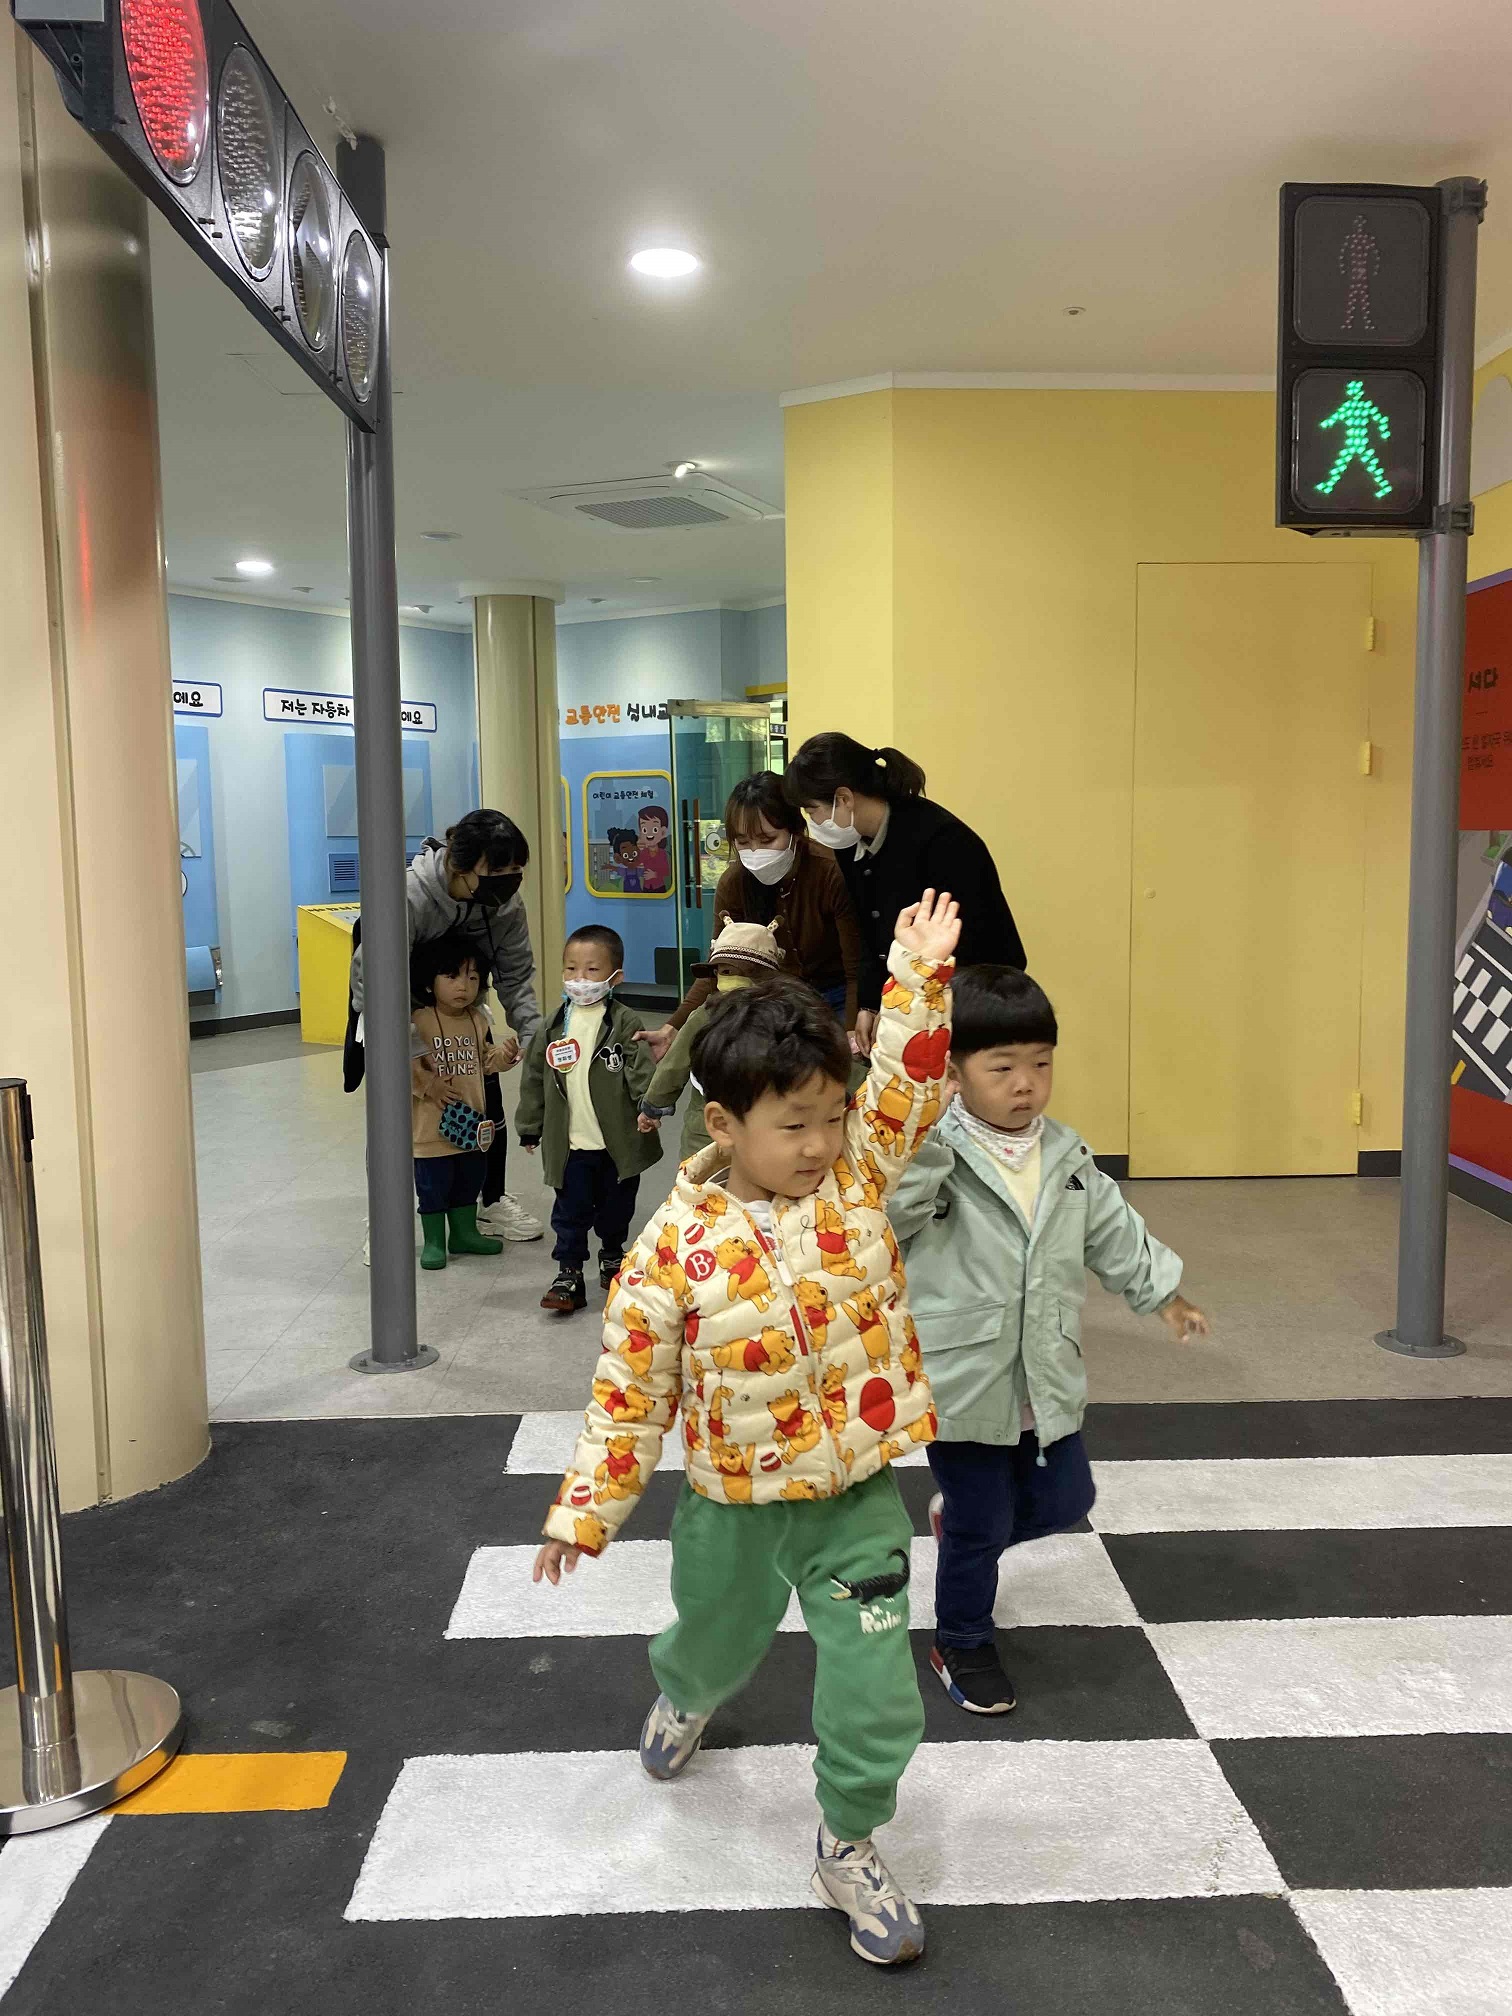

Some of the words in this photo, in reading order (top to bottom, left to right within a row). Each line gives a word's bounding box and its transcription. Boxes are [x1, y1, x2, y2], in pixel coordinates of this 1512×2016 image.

[280, 699, 307, 716] 저는
[311, 701, 350, 719] 자동차
[565, 703, 620, 726] 교통안전
